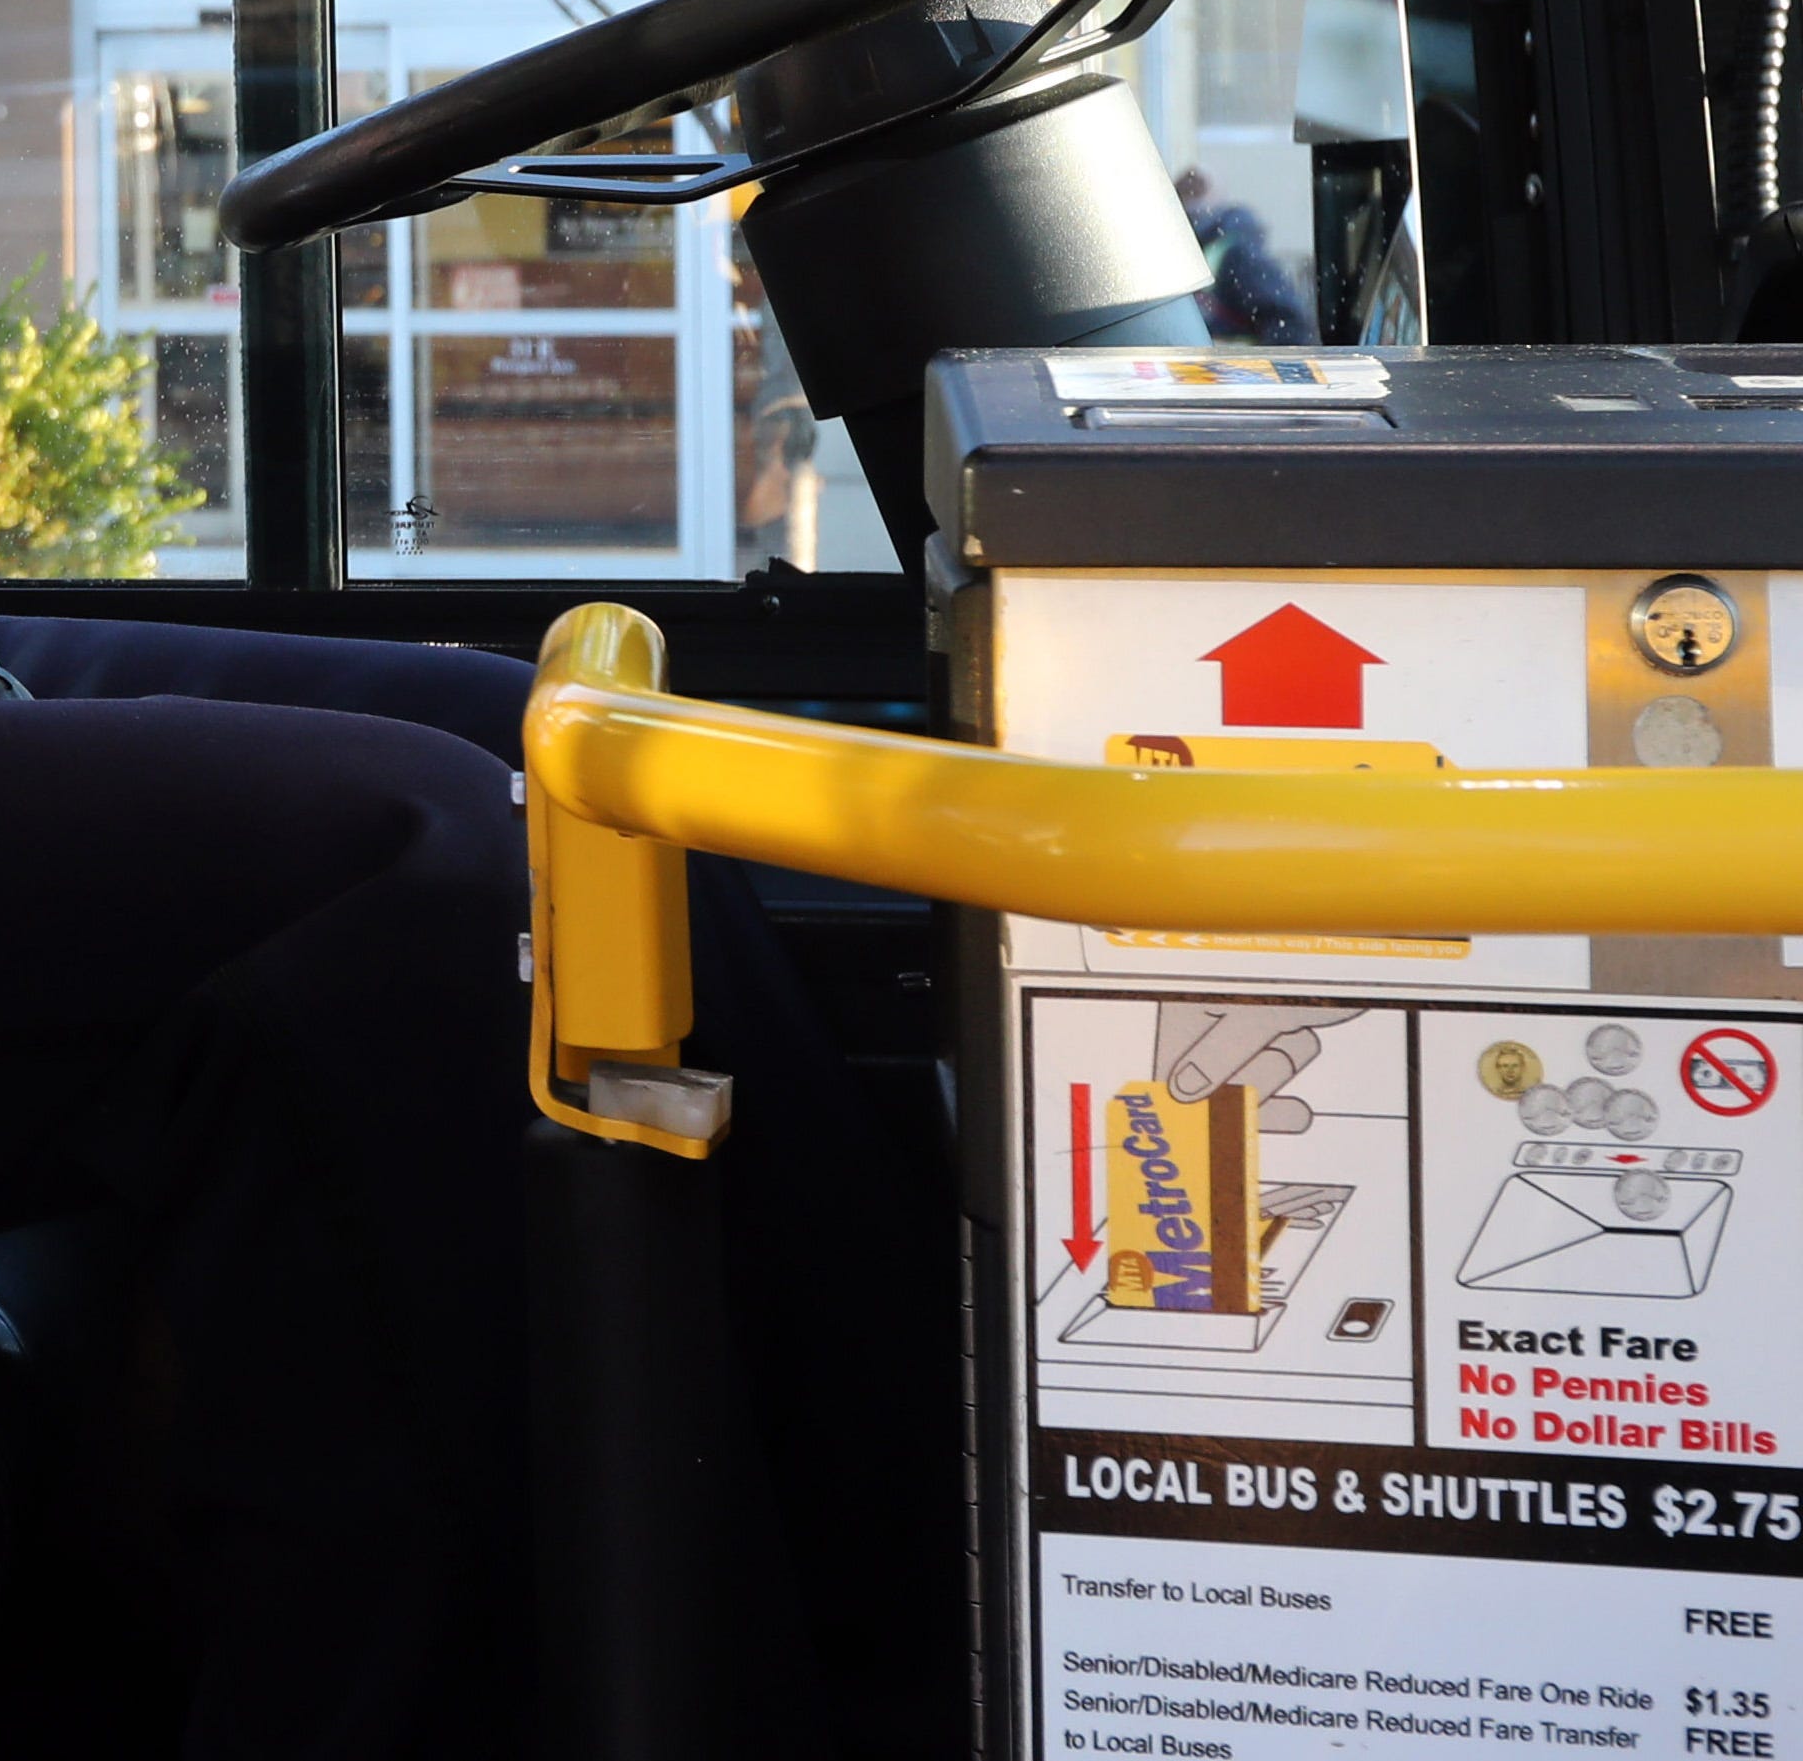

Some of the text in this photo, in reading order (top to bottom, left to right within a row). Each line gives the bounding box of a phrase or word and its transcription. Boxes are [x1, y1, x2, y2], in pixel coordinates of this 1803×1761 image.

[1114, 1092, 1215, 1309] MetroCard
[1115, 1256, 1144, 1292] MTA
[1457, 1319, 1700, 1362] Exact Fare
[1459, 1363, 1710, 1407] No Pennies
[1460, 1407, 1779, 1456] No Dollar Bills
[1064, 1453, 1803, 1542] LOCAL BUS & SHUTTLES $2.75
[1061, 1573, 1332, 1611] Transfer to Local Buses
[1684, 1607, 1774, 1639] FREE
[1063, 1650, 1654, 1711] Senior/Disabled/Medicare Reduced Fare One Ride
[1063, 1689, 1641, 1749] Senior/Disabled/Medicare Reduced Fare Transfer
[1684, 1686, 1771, 1719] $1.35
[1064, 1729, 1233, 1760] to Local Buses
[1685, 1727, 1774, 1759] FREE
